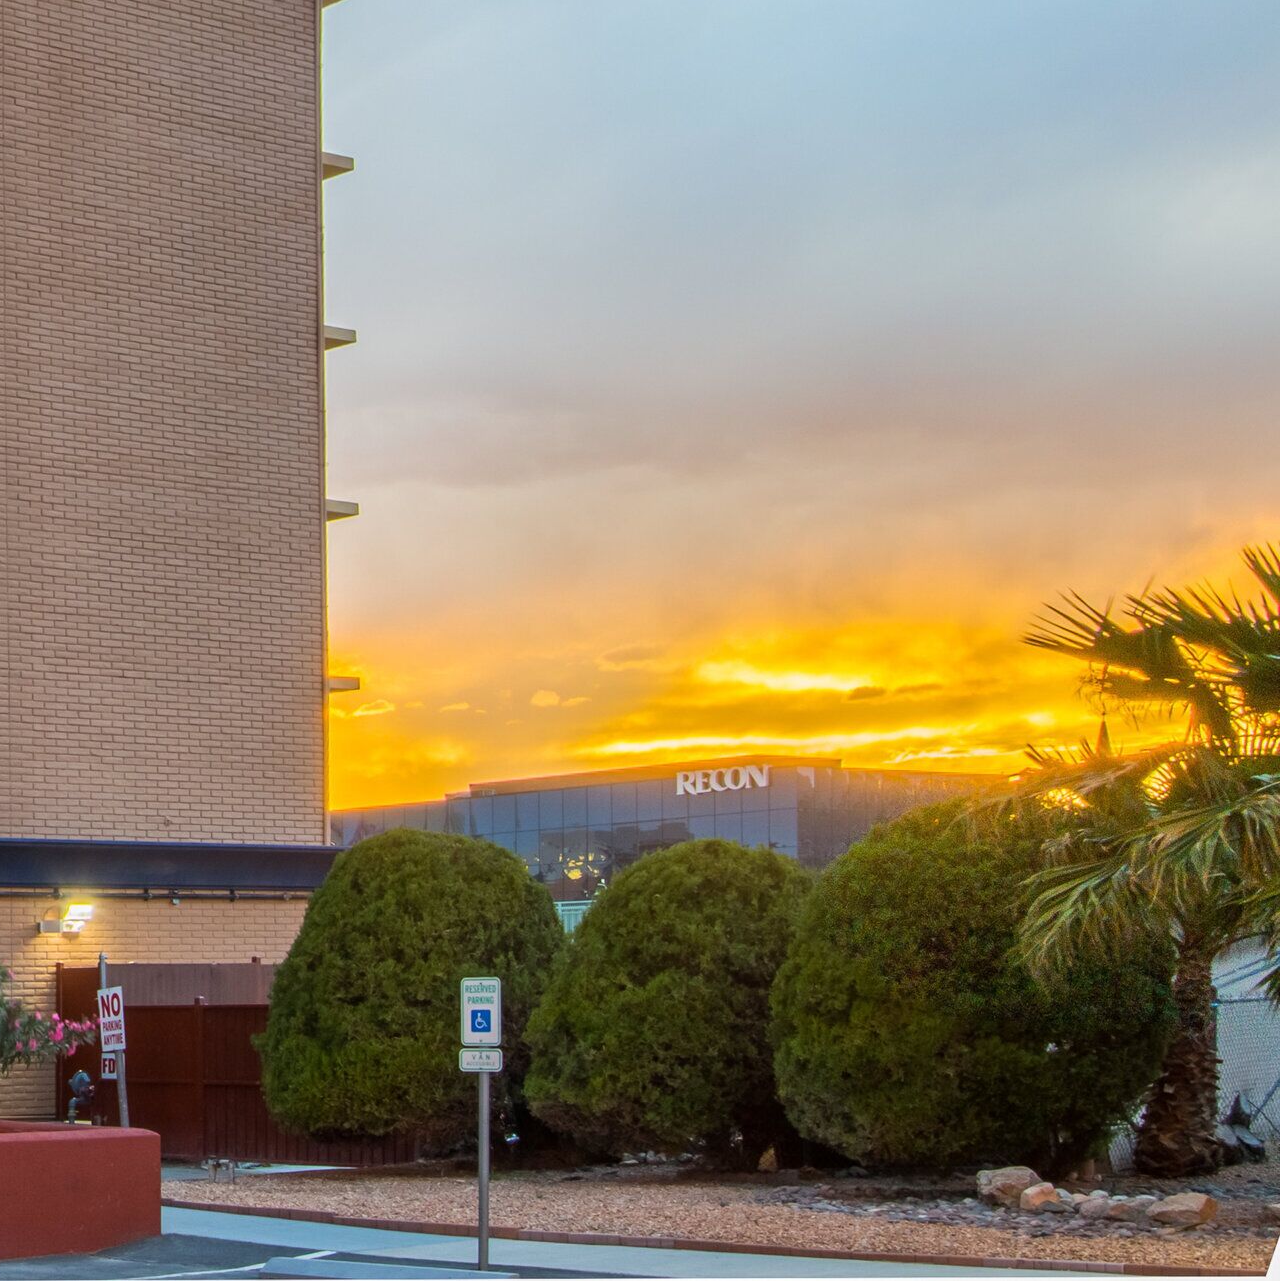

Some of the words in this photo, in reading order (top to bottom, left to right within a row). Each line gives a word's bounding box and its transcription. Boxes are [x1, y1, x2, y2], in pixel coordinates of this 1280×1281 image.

[675, 764, 773, 796] RECON
[464, 984, 497, 994] RESERVED
[100, 992, 121, 1018] NO
[467, 996, 495, 1005] PARKING
[102, 1019, 123, 1032] PARKING
[103, 1032, 124, 1046] ANYTIME
